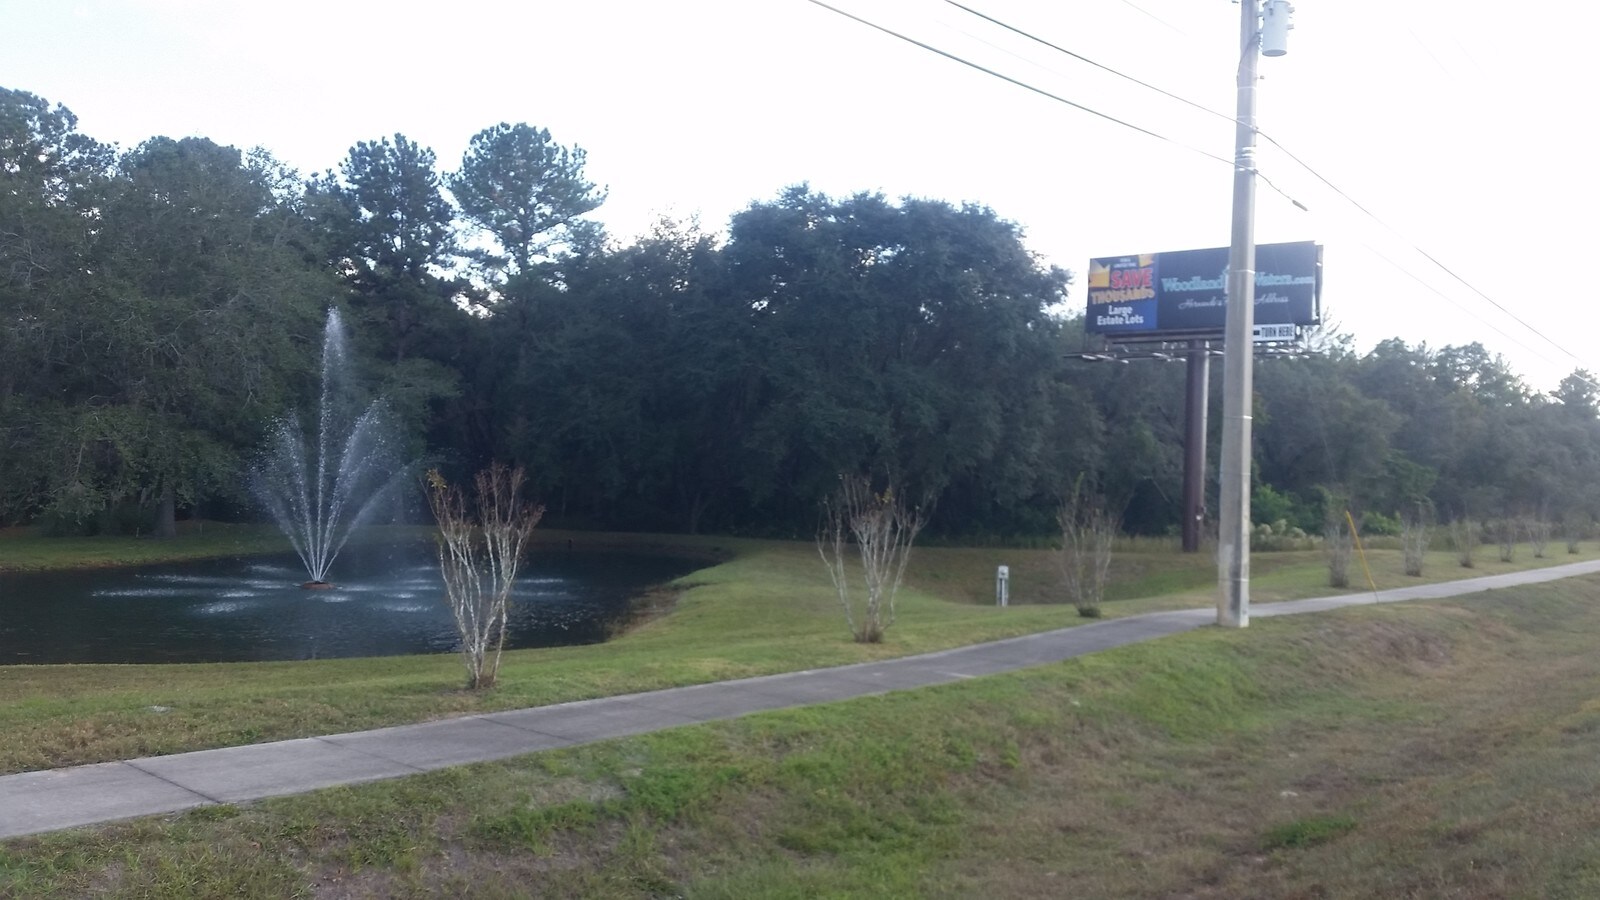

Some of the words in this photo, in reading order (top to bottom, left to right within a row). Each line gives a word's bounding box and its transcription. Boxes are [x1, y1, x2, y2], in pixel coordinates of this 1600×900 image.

[1111, 267, 1153, 290] SAVE
[1160, 275, 1224, 293] Woodland
[1090, 287, 1156, 305] THOUSANDS
[1108, 304, 1133, 317] Large
[1096, 316, 1124, 326] Estate
[1125, 314, 1144, 325] Lots
[1261, 326, 1277, 338] TURN
[1278, 326, 1293, 337] HERE
